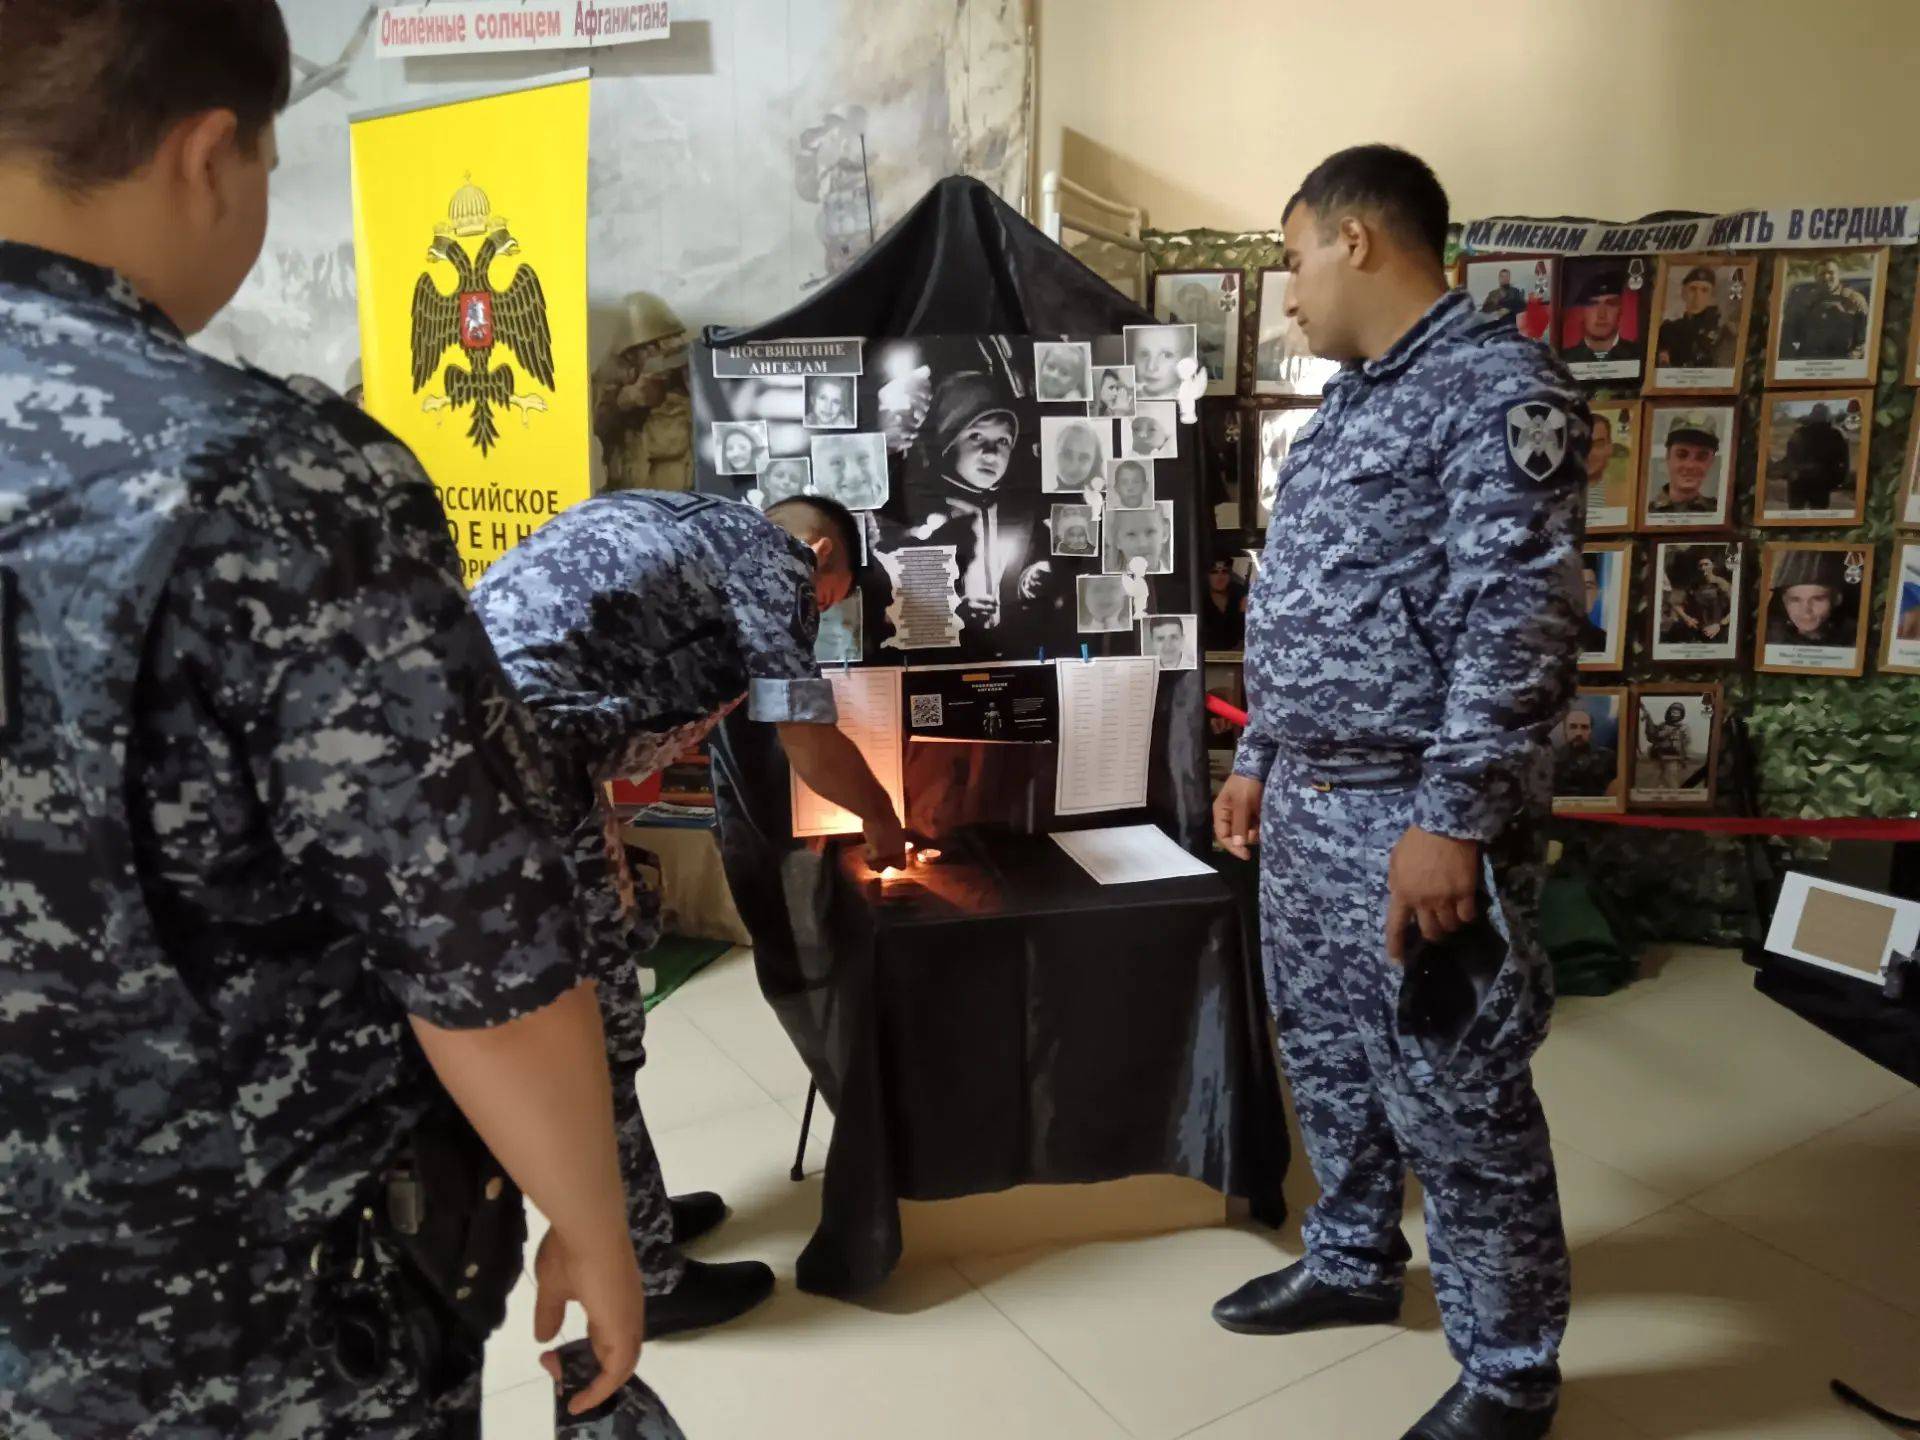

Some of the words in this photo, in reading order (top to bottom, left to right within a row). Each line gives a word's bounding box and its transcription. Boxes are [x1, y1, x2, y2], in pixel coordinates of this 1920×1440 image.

[381, 10, 466, 46] Опаленные
[474, 10, 561, 43] солнцем
[574, 0, 668, 45] Афганистана
[1464, 221, 1496, 245] ИХ
[1494, 223, 1587, 251] ИМЕНАМ
[1597, 223, 1699, 251] НАВЕЧНО
[1706, 210, 1774, 247] ЖИТЬ
[1787, 208, 1804, 240] В
[1808, 205, 1908, 244] СЕРДЦАХ
[729, 343, 846, 359] ПОСВЯЩЕНИЕ
[749, 361, 828, 374] АНГЕЛАМ
[434, 482, 559, 515] ОССИЙСКОЕ
